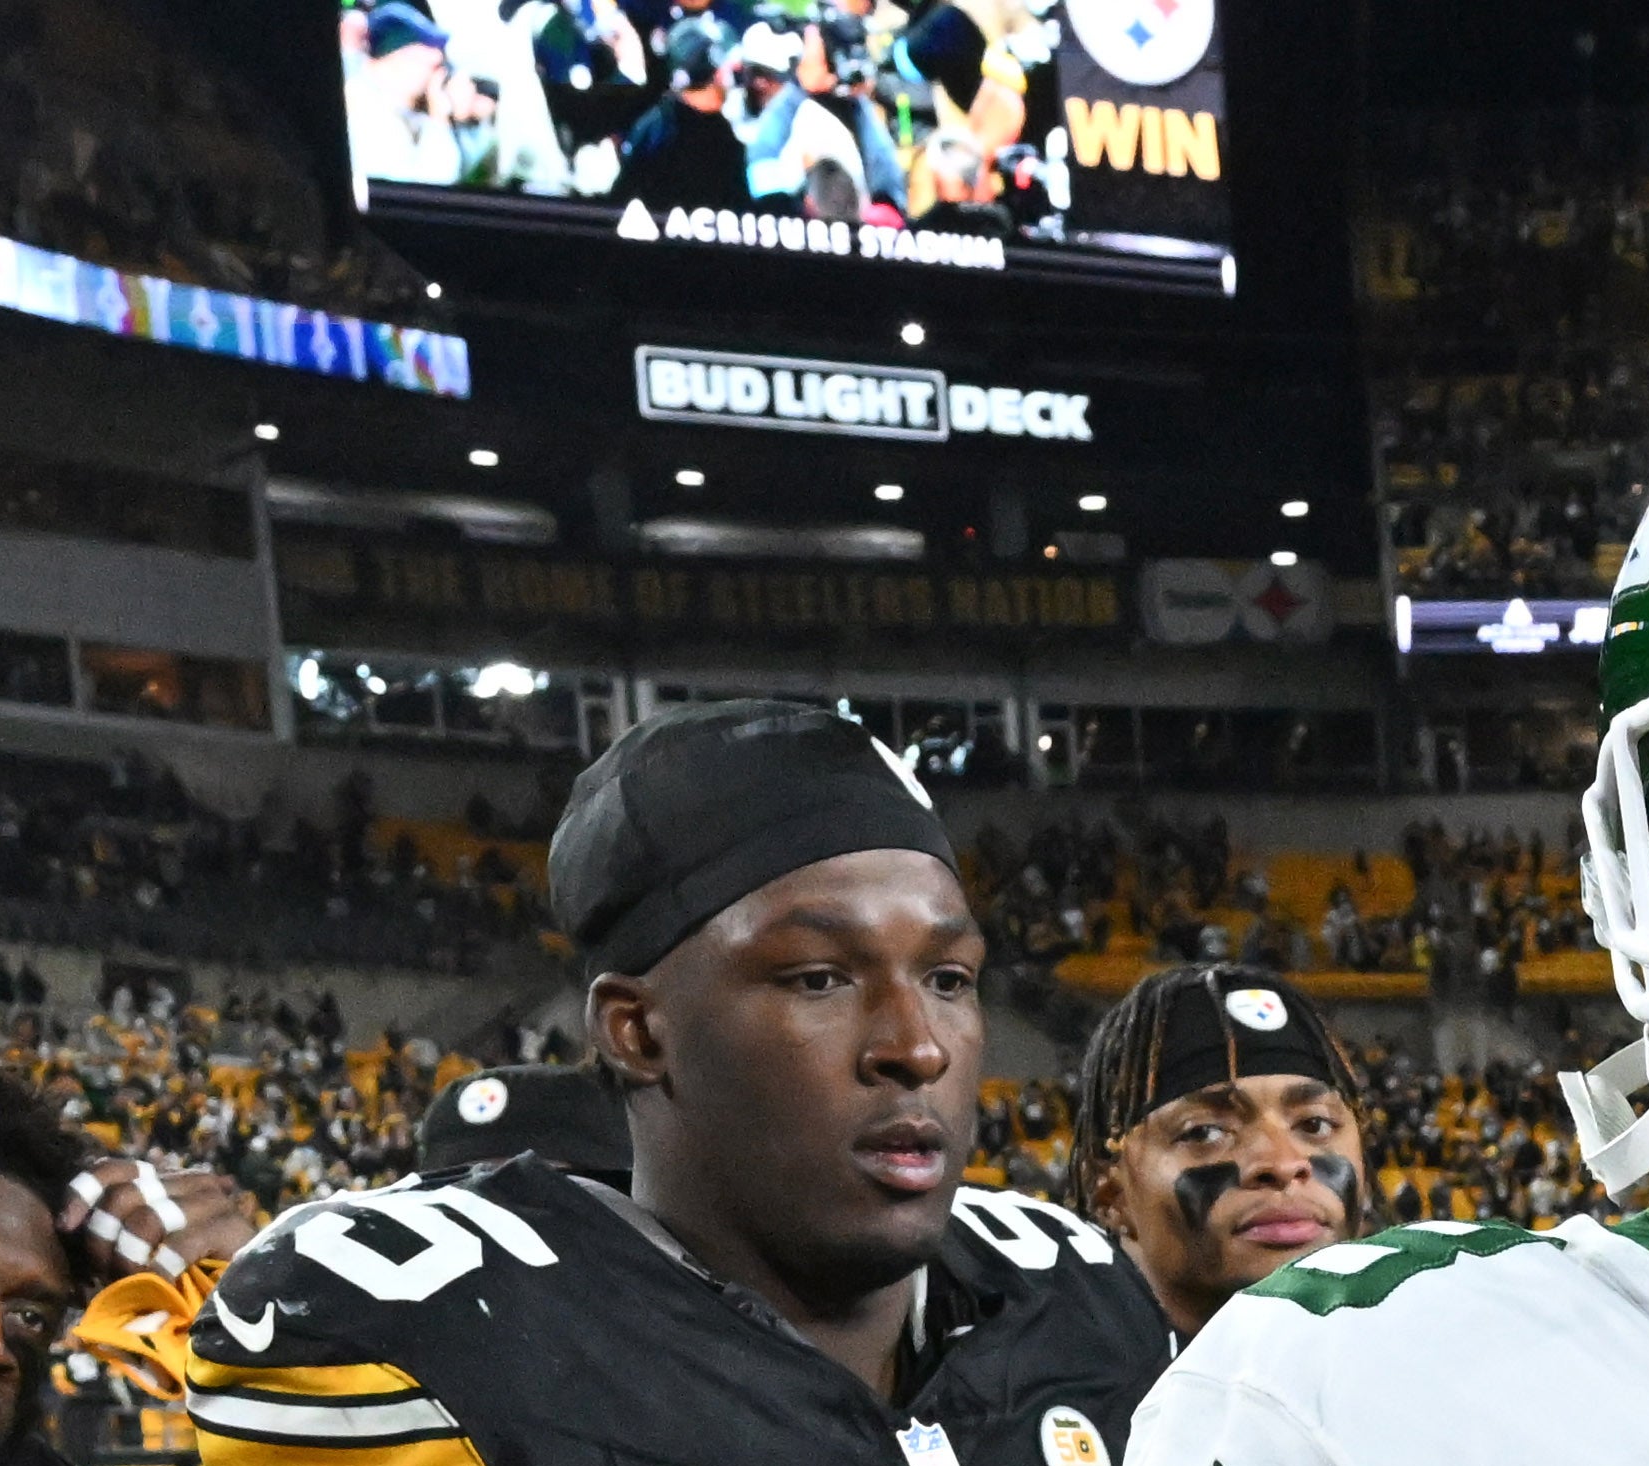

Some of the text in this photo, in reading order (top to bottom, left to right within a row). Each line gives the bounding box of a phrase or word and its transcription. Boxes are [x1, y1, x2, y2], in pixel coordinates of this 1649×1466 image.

[1064, 96, 1221, 181] WIN
[664, 207, 1005, 270] ACRISURE STADIUM
[650, 360, 1092, 441] BUD LIGHT DECK
